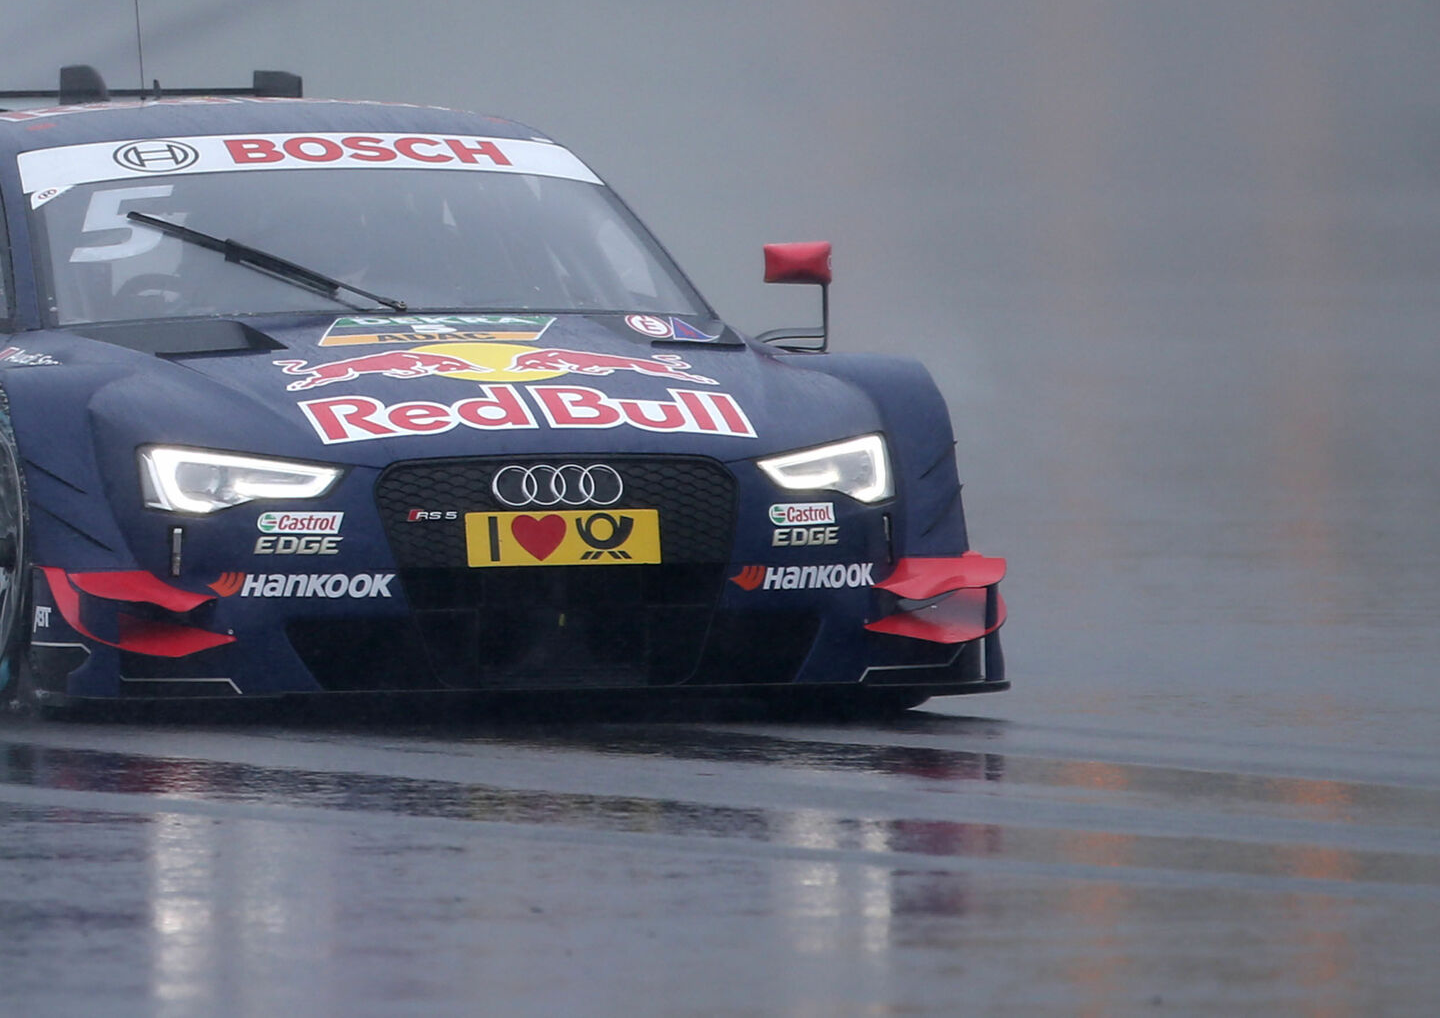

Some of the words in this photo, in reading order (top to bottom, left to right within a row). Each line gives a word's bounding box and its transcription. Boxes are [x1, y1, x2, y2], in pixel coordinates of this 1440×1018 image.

[223, 136, 514, 166] BOSCH
[69, 184, 174, 263] 5
[349, 316, 539, 325] DEKRA
[410, 324, 458, 334] 5
[376, 332, 496, 342] ADAC
[298, 384, 539, 444] Red
[526, 385, 758, 438] Bull
[278, 514, 338, 531] Castrol
[415, 510, 441, 521] RS
[445, 510, 458, 520] 5
[786, 506, 833, 523] Castrol
[772, 526, 841, 547] EDGE
[253, 536, 344, 555] EDGE
